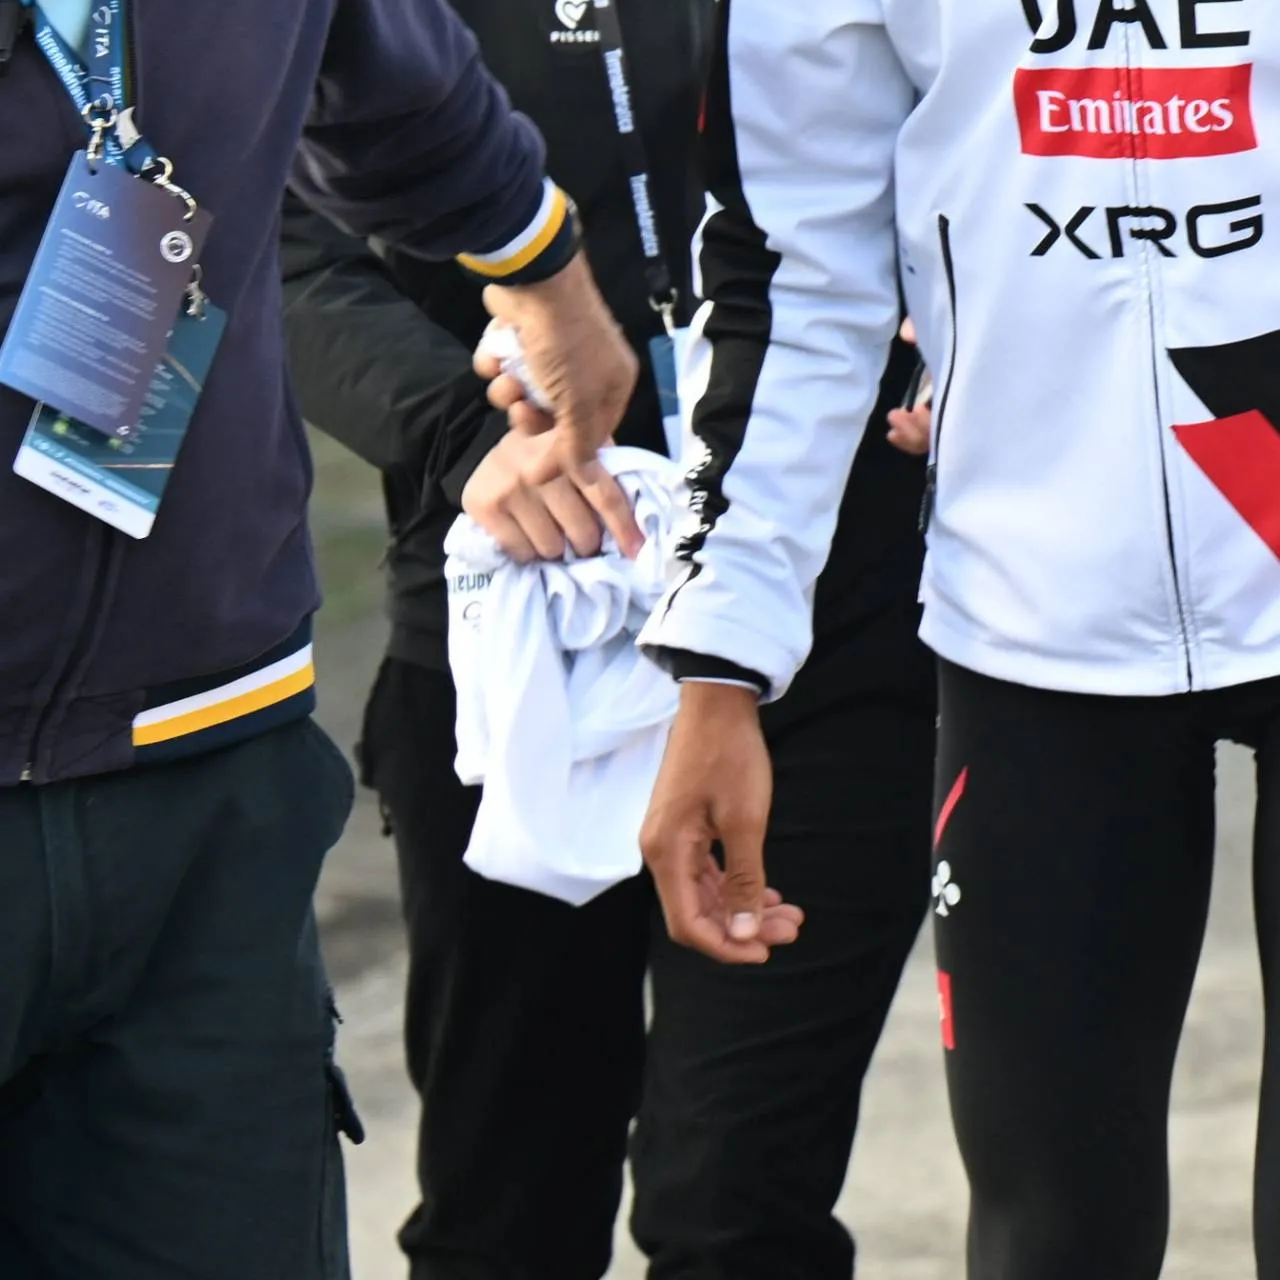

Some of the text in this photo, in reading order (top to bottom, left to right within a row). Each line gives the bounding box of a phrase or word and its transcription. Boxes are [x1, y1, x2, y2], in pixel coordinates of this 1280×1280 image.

[35, 25, 90, 115] TirrenoAdriatic
[95, 28, 111, 58] ITA
[1036, 88, 1234, 136] Emirates
[1023, 194, 1264, 260] XRG
